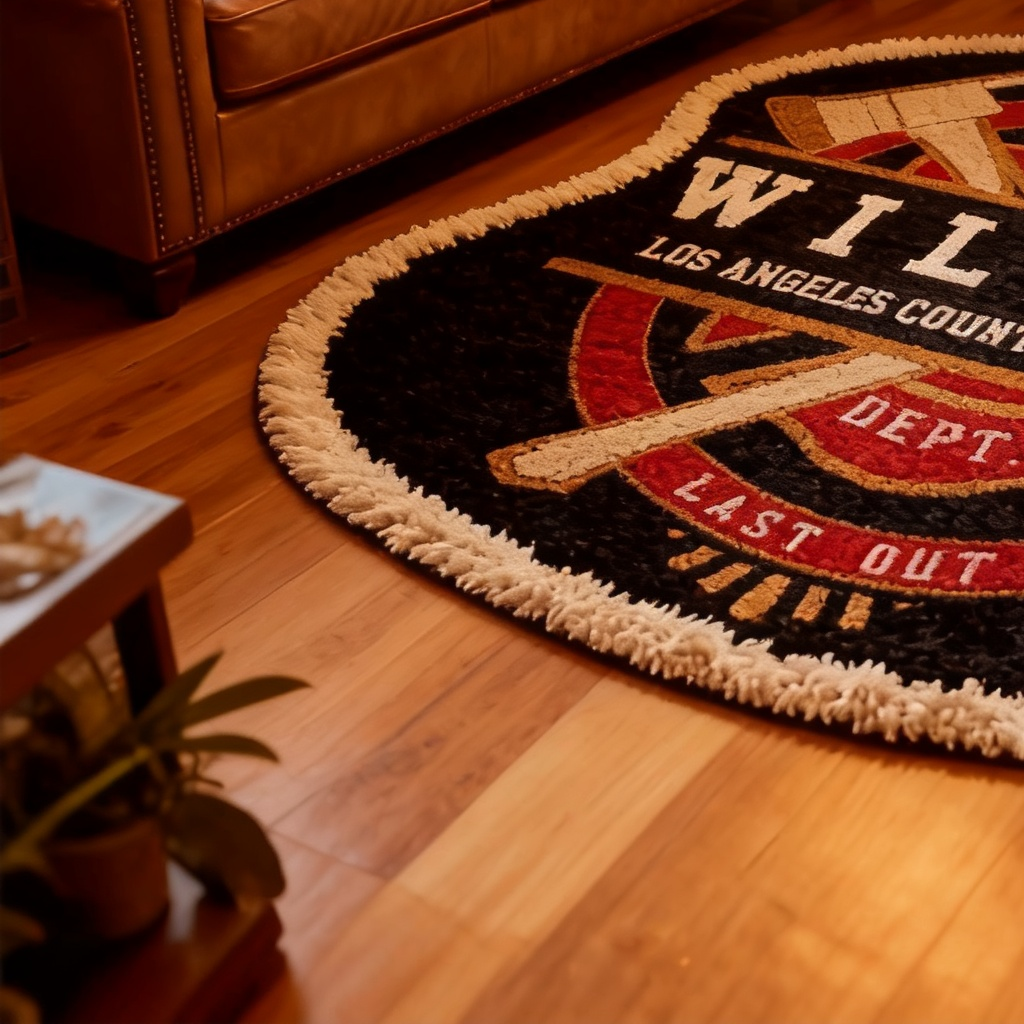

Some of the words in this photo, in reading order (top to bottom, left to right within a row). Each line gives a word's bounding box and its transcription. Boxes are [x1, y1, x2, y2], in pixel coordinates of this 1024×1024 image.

[635, 235, 721, 271] LOS
[719, 257, 898, 314] ANGELES
[839, 395, 1019, 466] DEPT.
[673, 473, 823, 552] LAST
[859, 543, 998, 585] OUT
